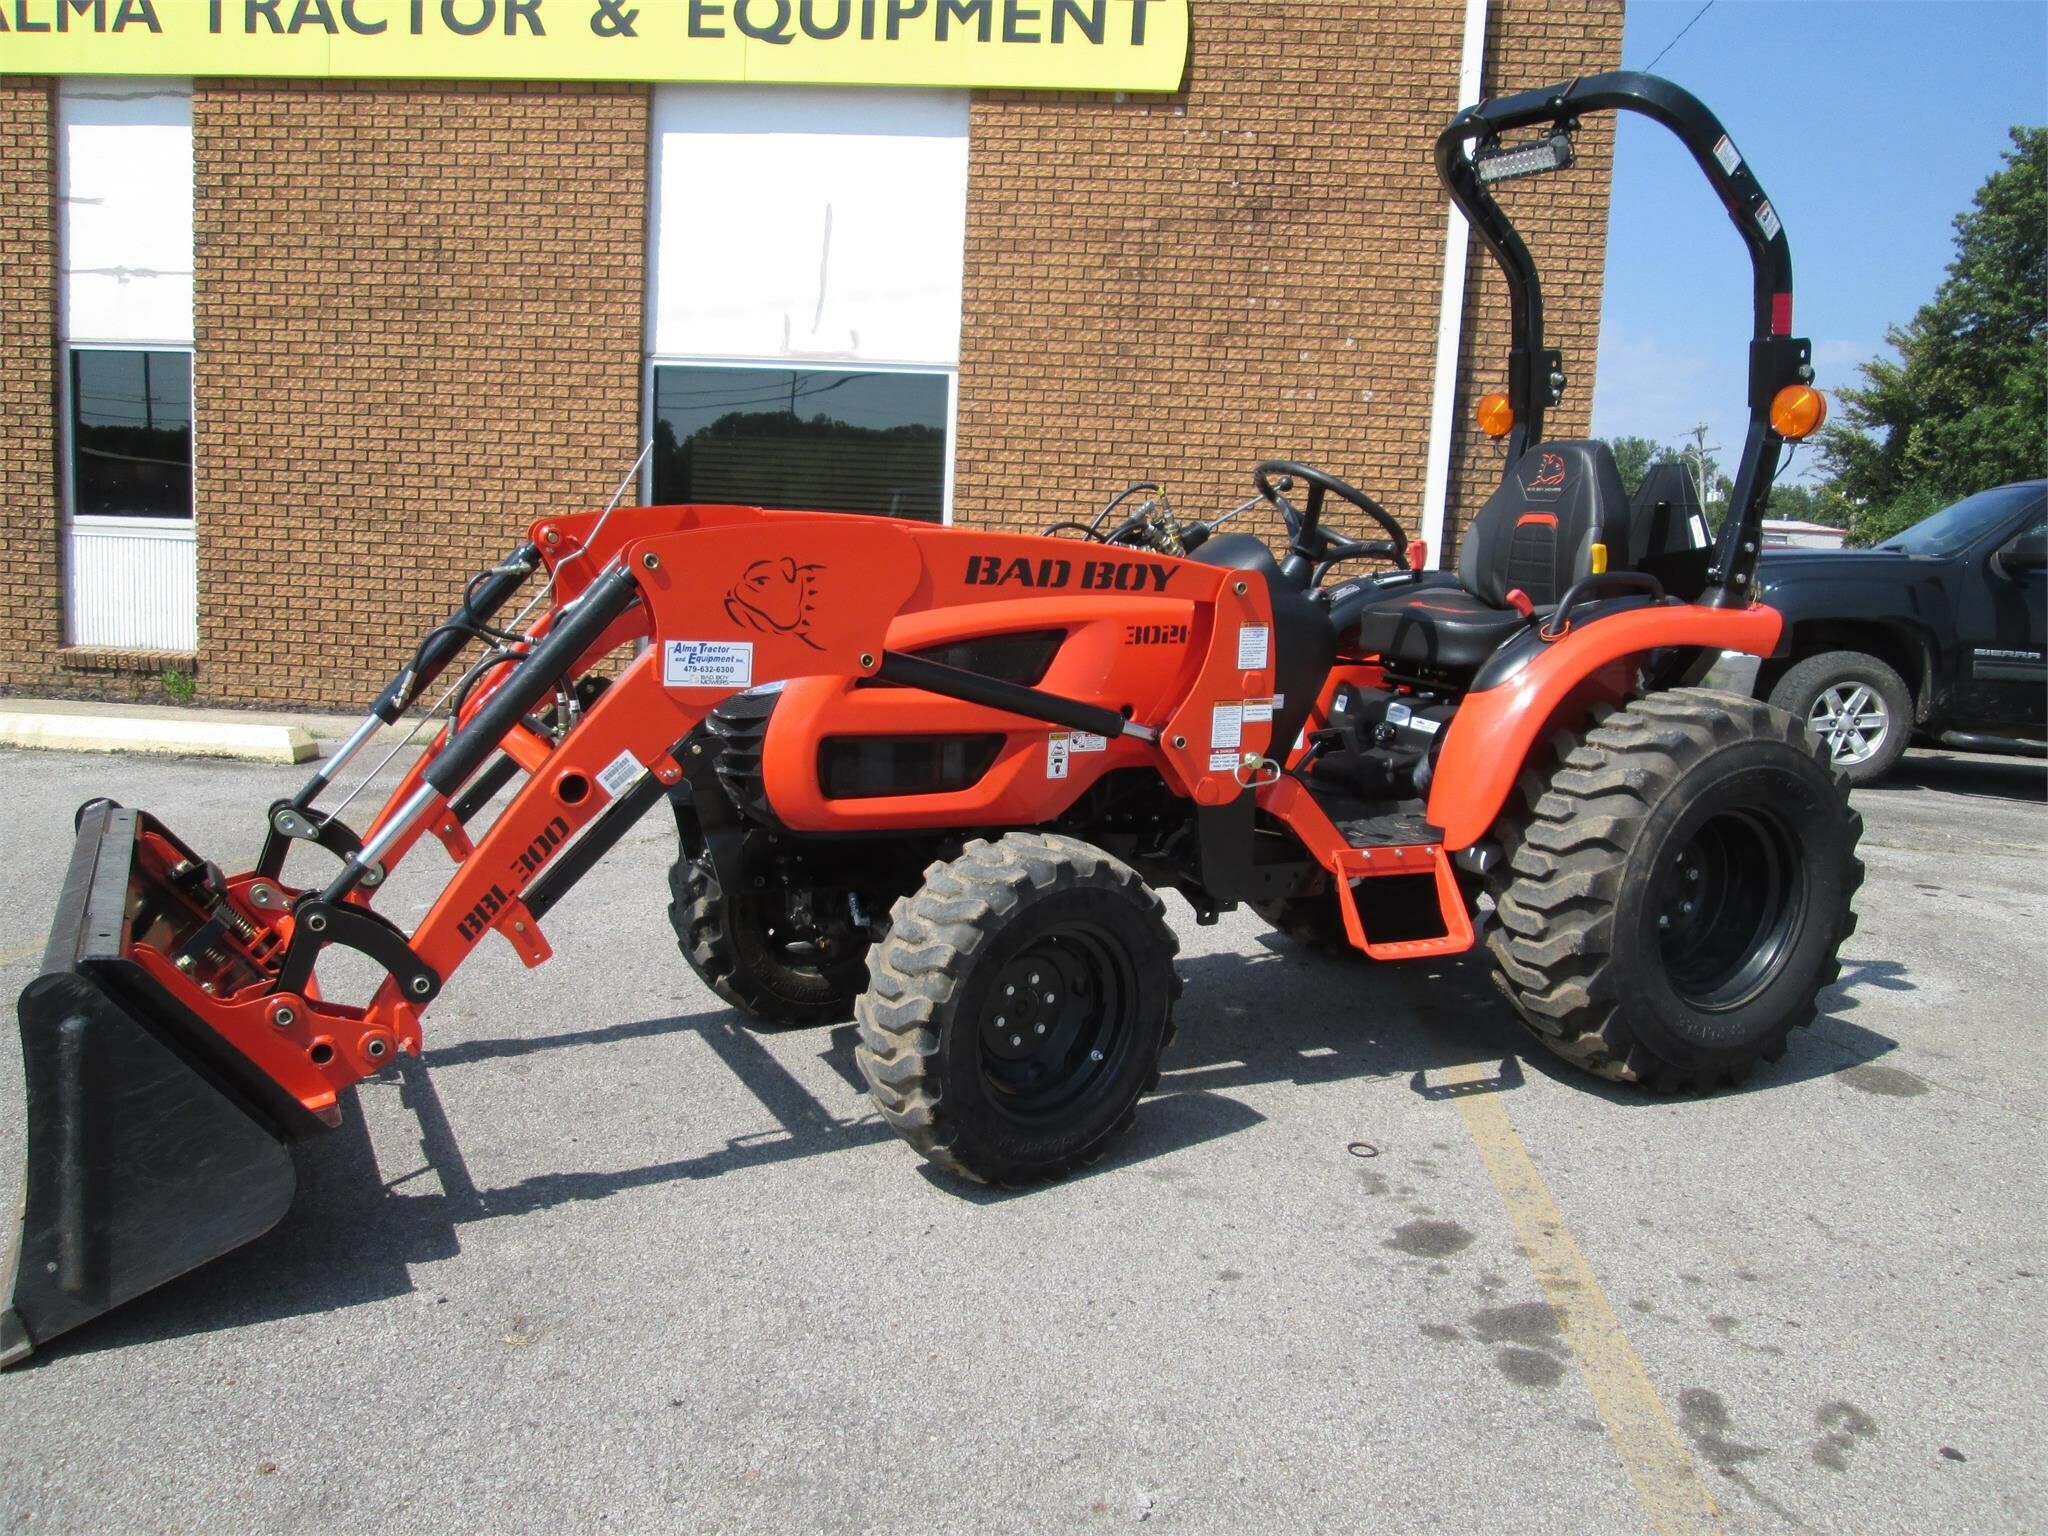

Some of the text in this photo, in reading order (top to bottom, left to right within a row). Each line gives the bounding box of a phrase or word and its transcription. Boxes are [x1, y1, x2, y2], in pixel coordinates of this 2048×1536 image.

[205, 0, 546, 36] TRACTOR
[590, 0, 640, 37] &
[688, 0, 1166, 46] EQUIPMENT
[964, 555, 1181, 592] BAD BOY
[673, 642, 731, 654] Alma Tractor
[1974, 648, 2040, 659] SIERRA
[688, 653, 735, 665] Equipment
[683, 665, 735, 673] 479-632-6300
[509, 816, 570, 883] 300
